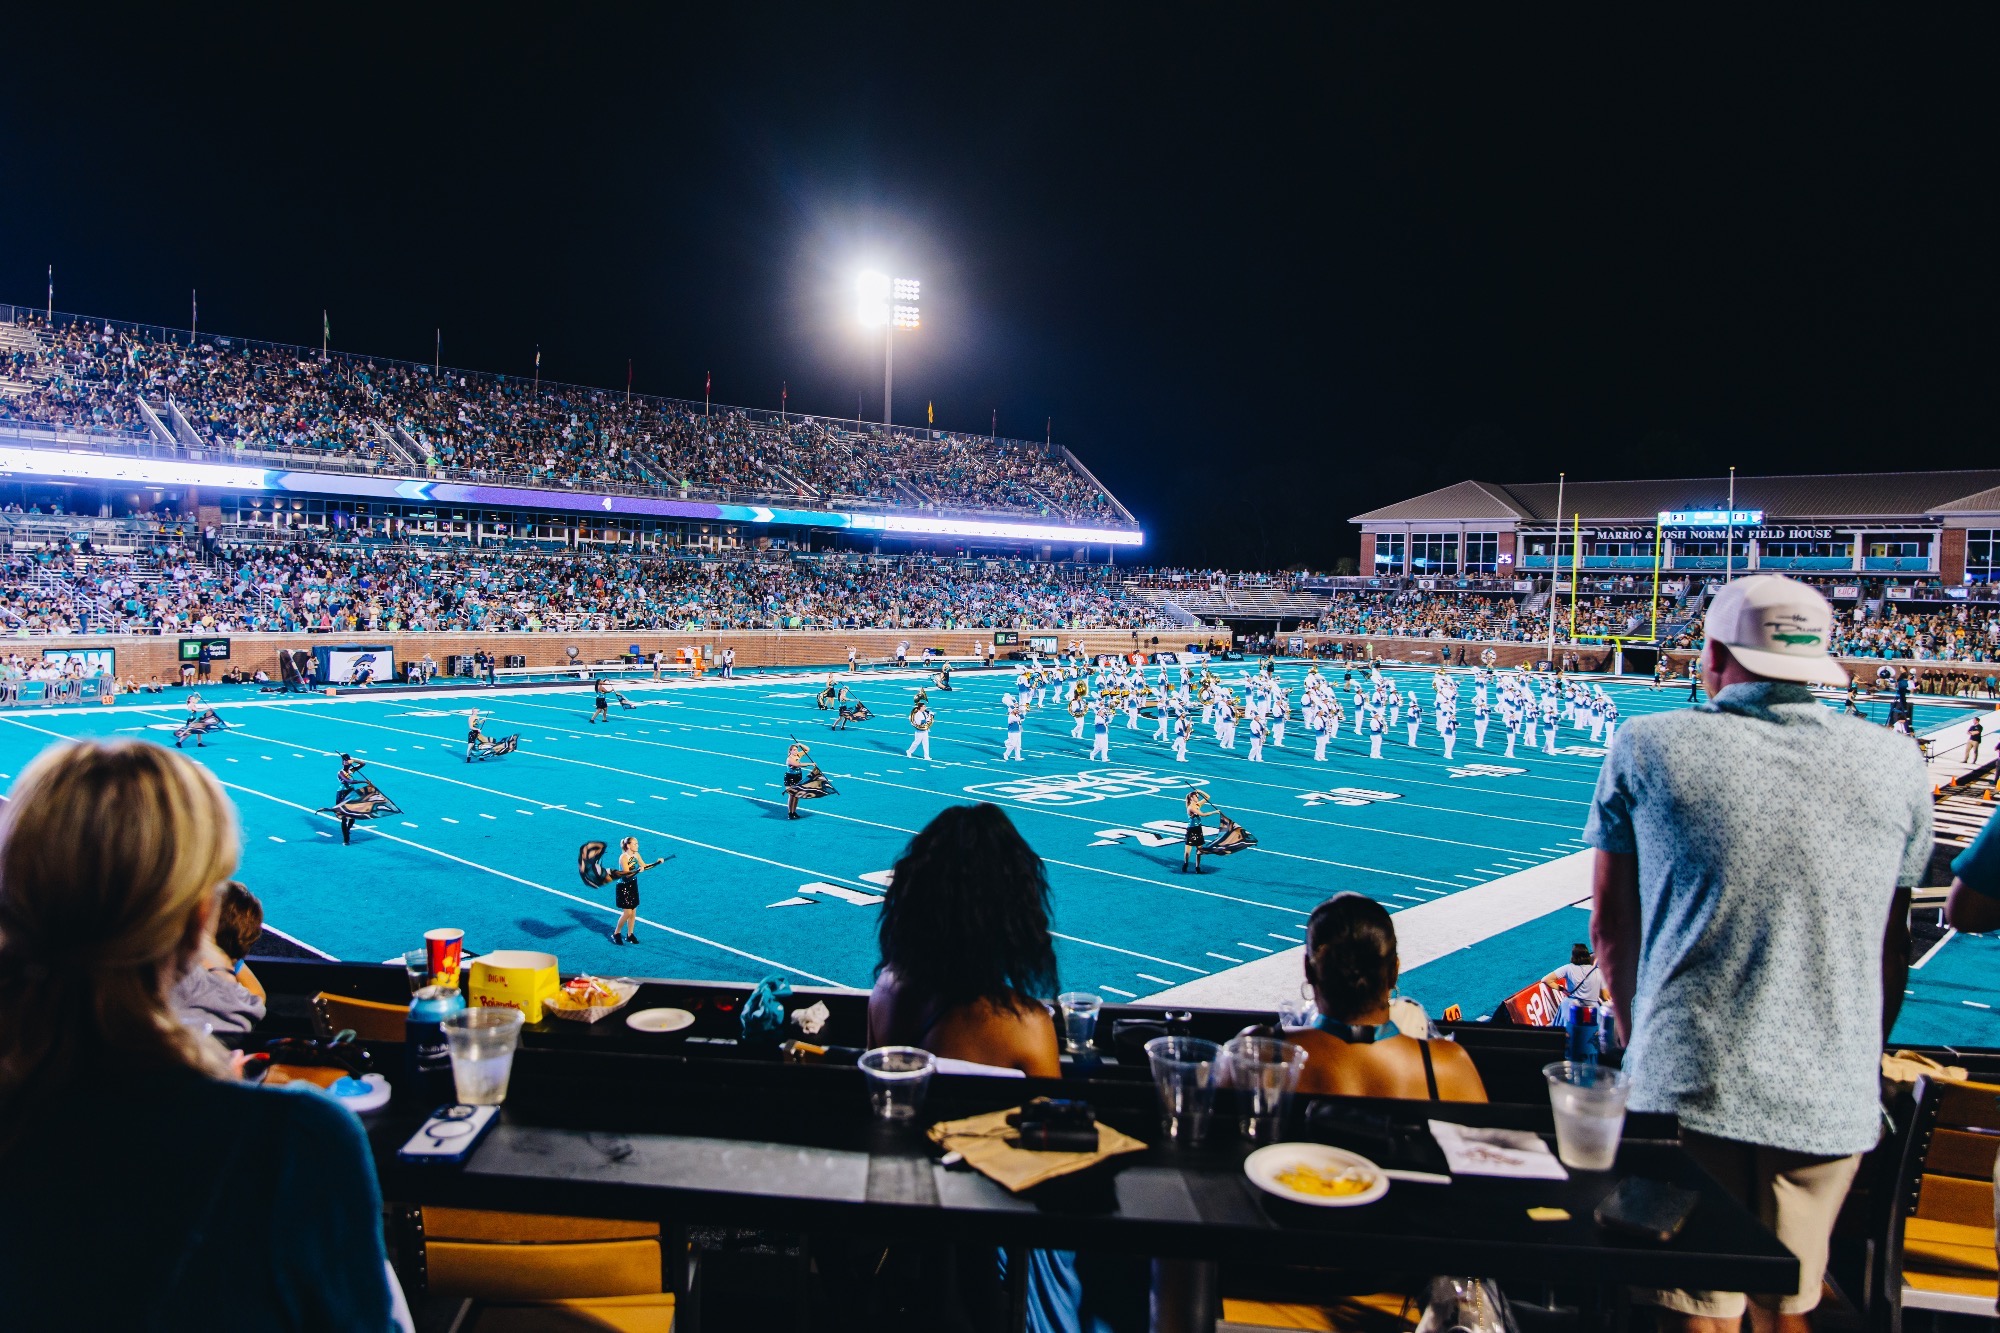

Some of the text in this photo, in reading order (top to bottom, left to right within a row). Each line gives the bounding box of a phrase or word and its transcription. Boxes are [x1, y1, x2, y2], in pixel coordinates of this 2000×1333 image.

[1597, 530, 1642, 540] MARRIO
[1645, 531, 1653, 540] &
[1690, 530, 1743, 540] NORMAN
[1748, 530, 1785, 539] FIELD
[1789, 529, 1832, 539] HOUSE
[1498, 554, 1513, 564] 25
[185, 645, 200, 655] TD
[104, 696, 113, 704] 10
